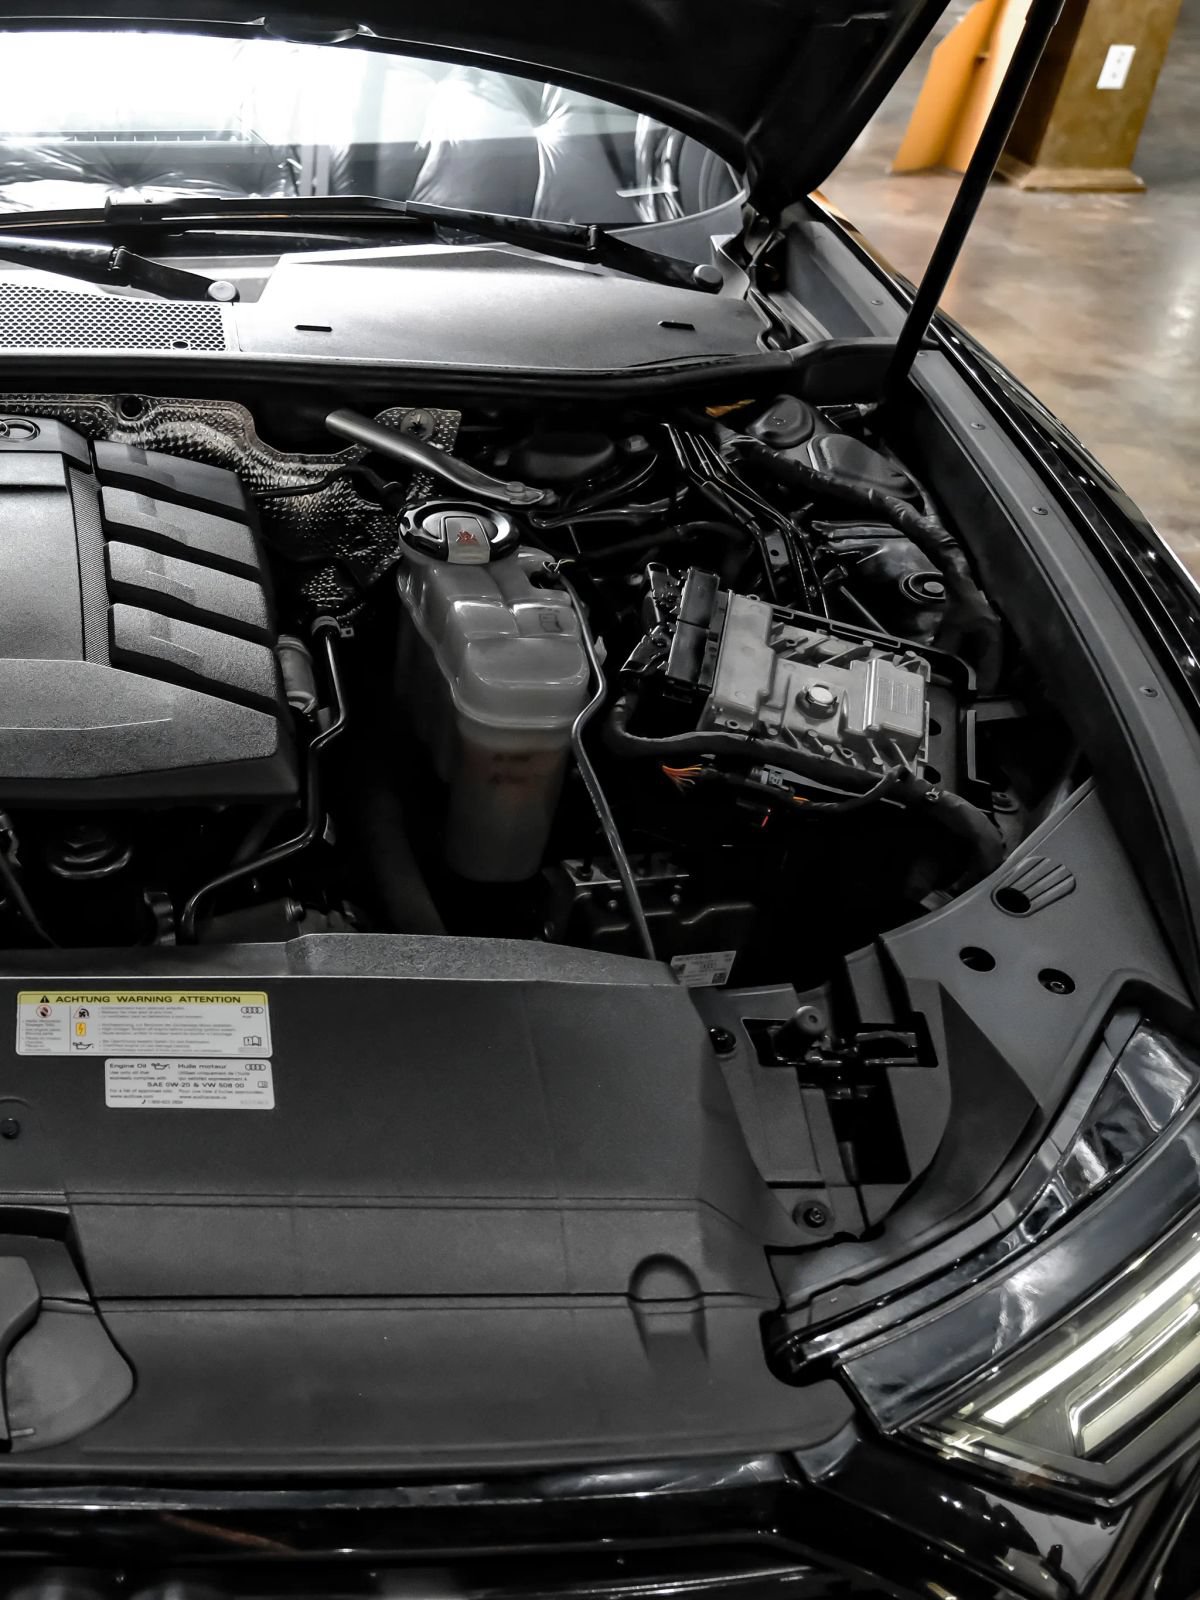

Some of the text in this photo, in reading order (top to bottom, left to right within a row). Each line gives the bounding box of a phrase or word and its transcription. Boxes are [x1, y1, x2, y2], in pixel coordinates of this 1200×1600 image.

[55, 995, 242, 1004] ACHTUNG WARNING ATTENTION
